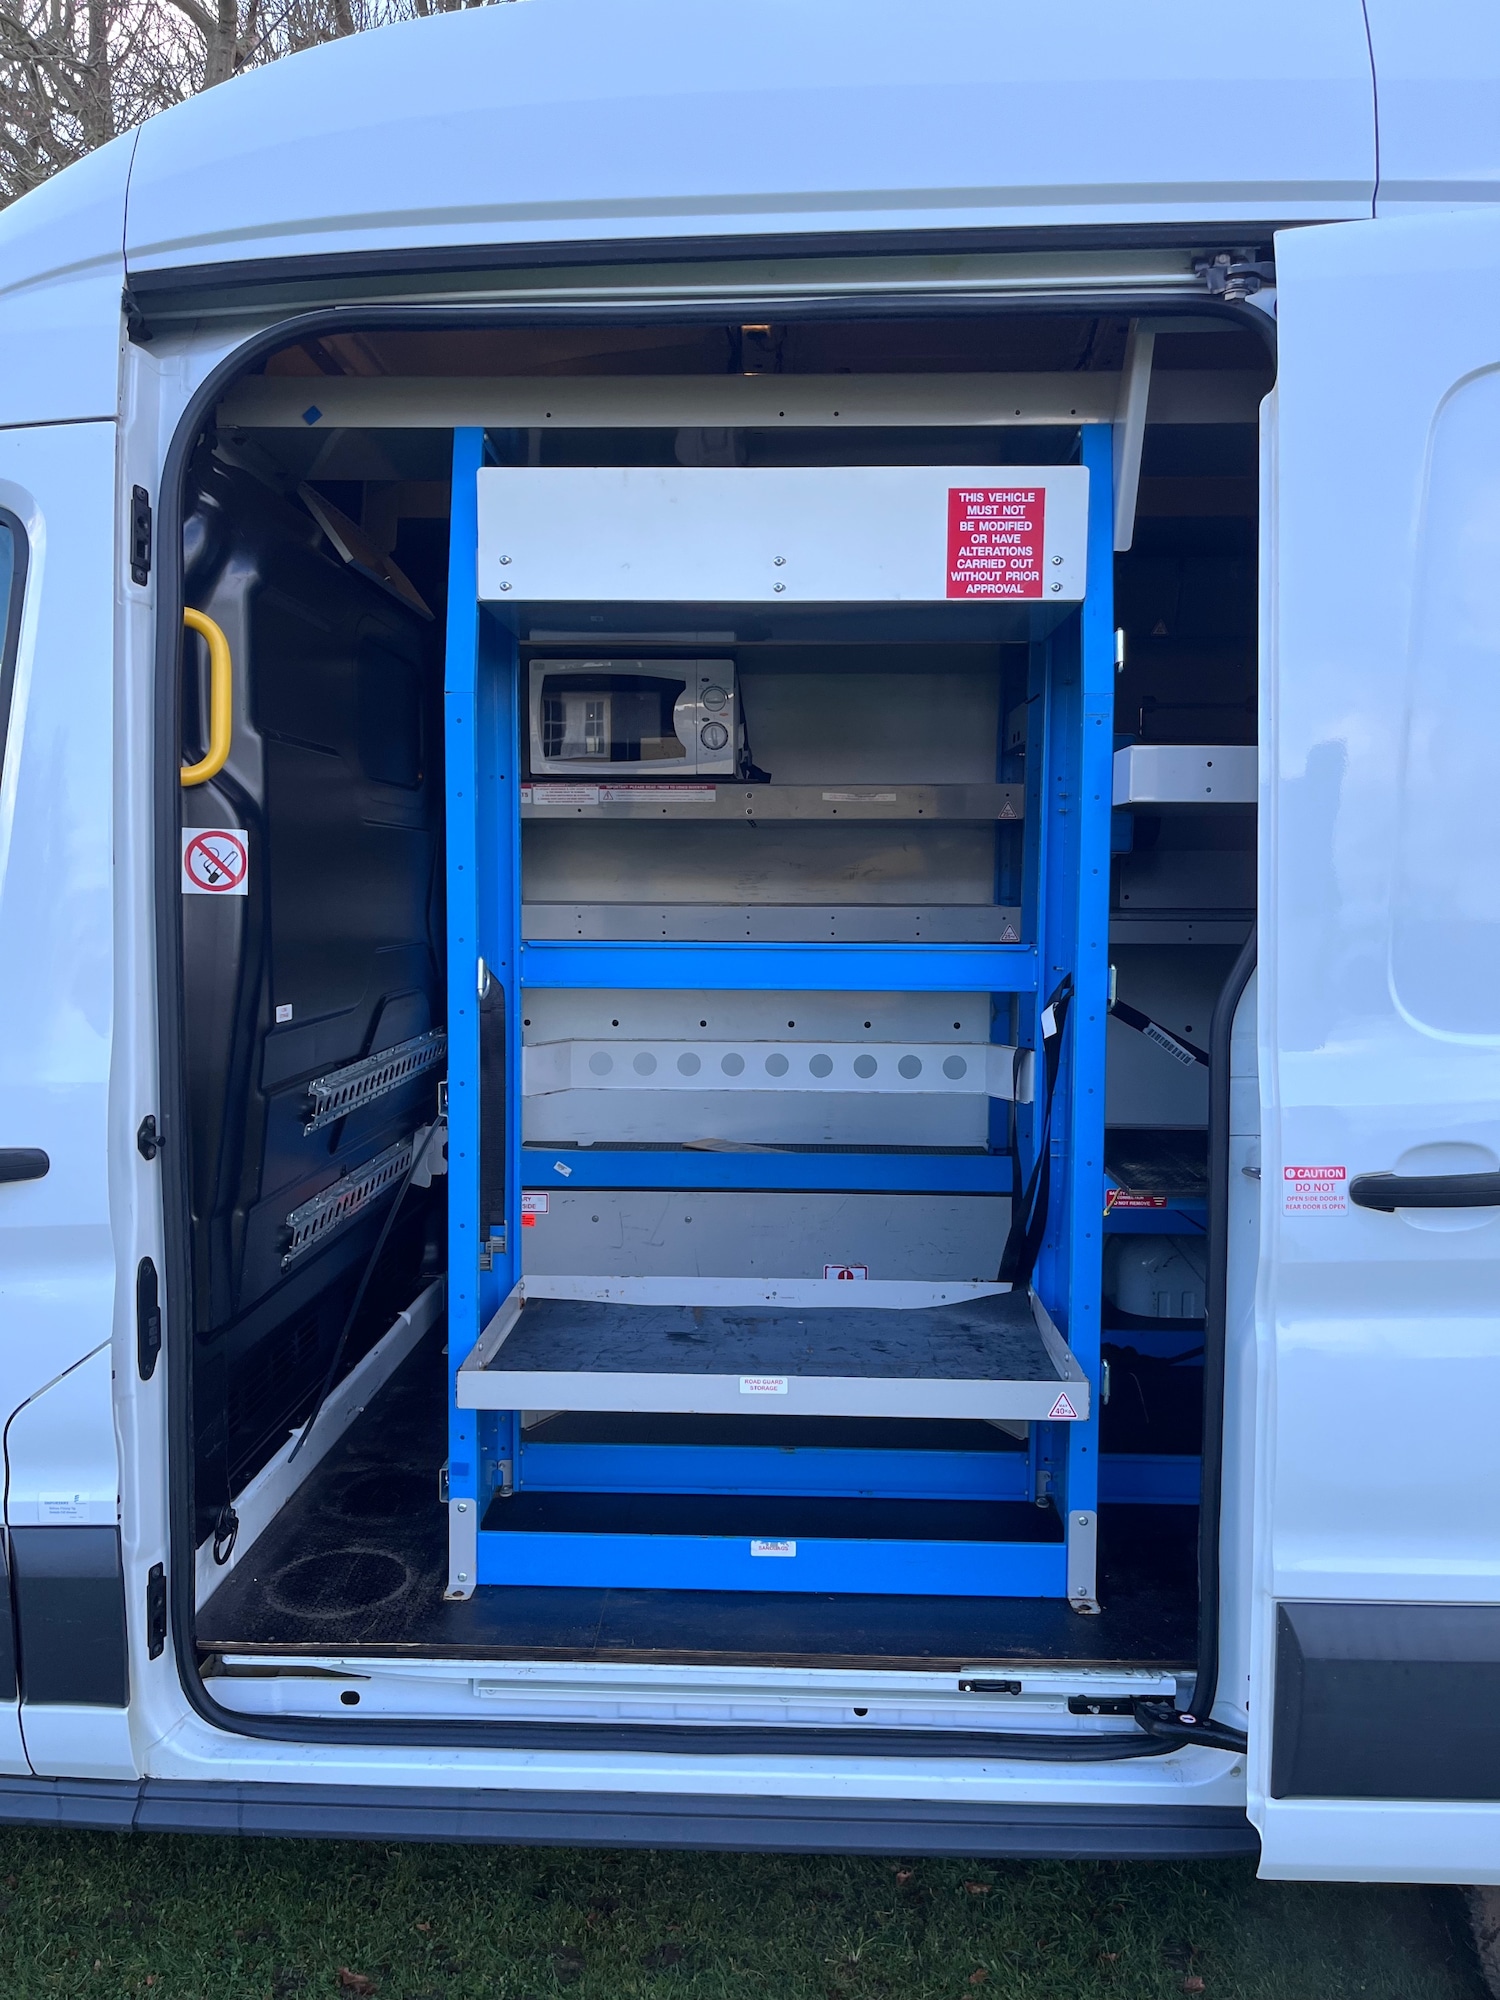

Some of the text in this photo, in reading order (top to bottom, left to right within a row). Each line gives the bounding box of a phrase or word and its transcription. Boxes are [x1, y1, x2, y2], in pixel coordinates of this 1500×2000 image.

[959, 492, 1036, 503] THIS VEHICLE
[967, 505, 1026, 515] MUST NOT
[959, 521, 1032, 531] BE MODIFIED
[971, 534, 1021, 544] OR HAVE
[958, 546, 1033, 556] ALTERATIONS
[957, 559, 1034, 569] CARRIED OUT
[951, 571, 1040, 581] WITHOUT PRIOR
[966, 584, 1024, 593] APPROVAL
[1297, 1169, 1343, 1178] CAUTION
[1295, 1183, 1336, 1192] DO NOT
